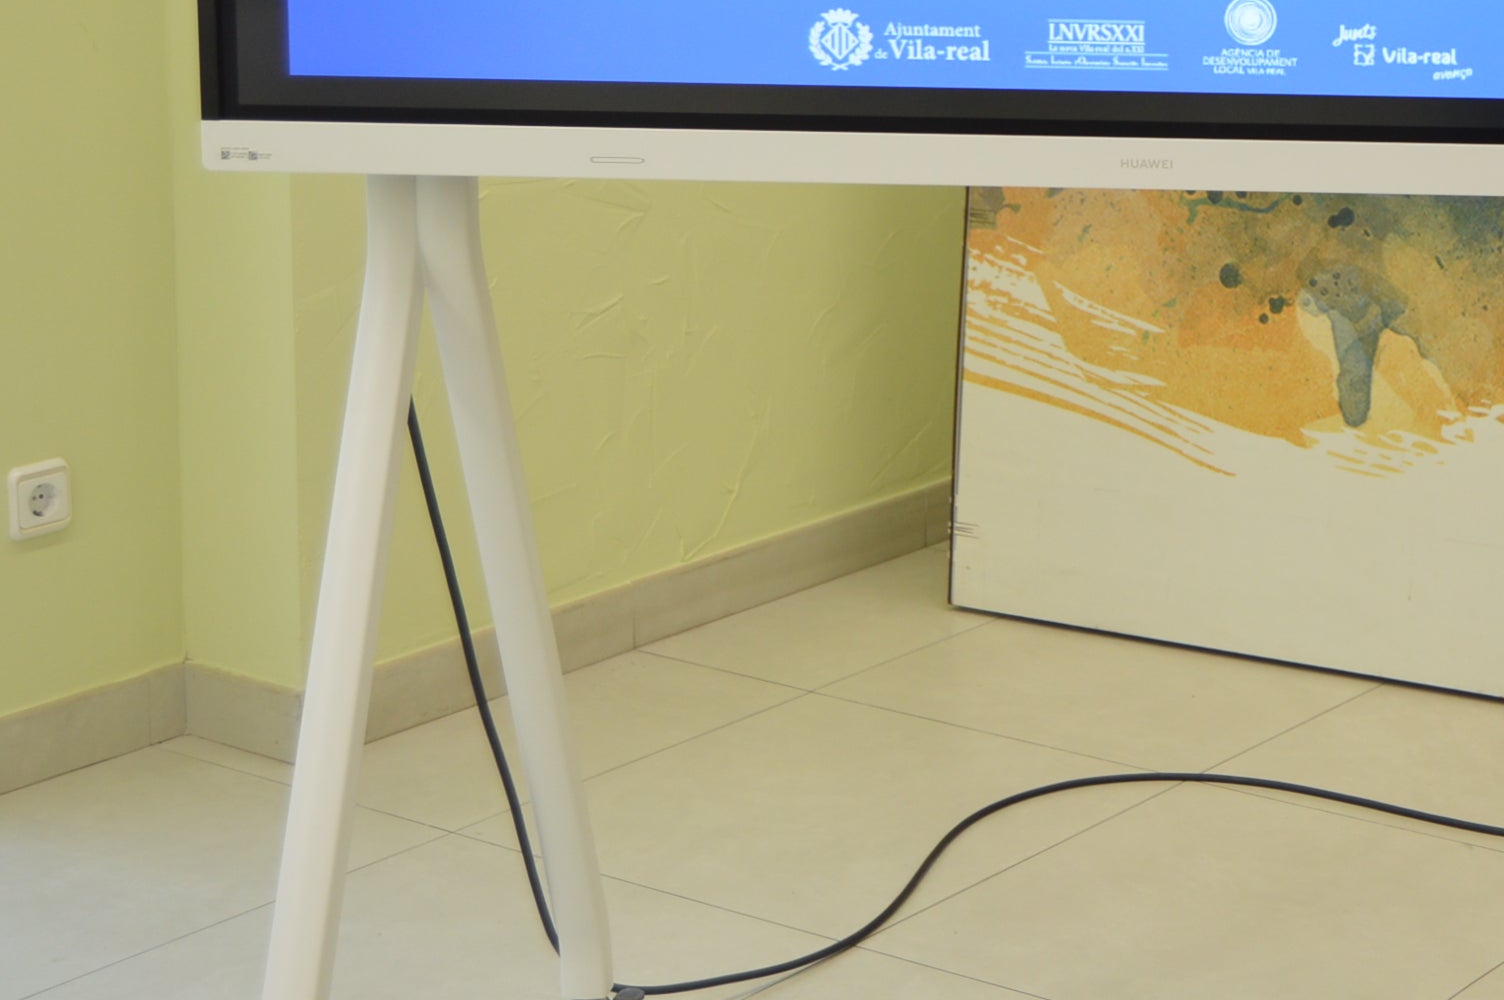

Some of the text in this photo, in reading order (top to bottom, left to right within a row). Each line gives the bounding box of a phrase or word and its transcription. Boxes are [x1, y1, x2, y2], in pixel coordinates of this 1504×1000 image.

[884, 21, 981, 40] Ajuntament
[1049, 23, 1145, 42] LNVRSXXI
[874, 39, 990, 62] de Vila-real
[1267, 49, 1281, 58] DE
[1382, 47, 1457, 65] Vila-real
[1213, 65, 1245, 75] LOCAL
[1120, 158, 1174, 169] HUAWEI
